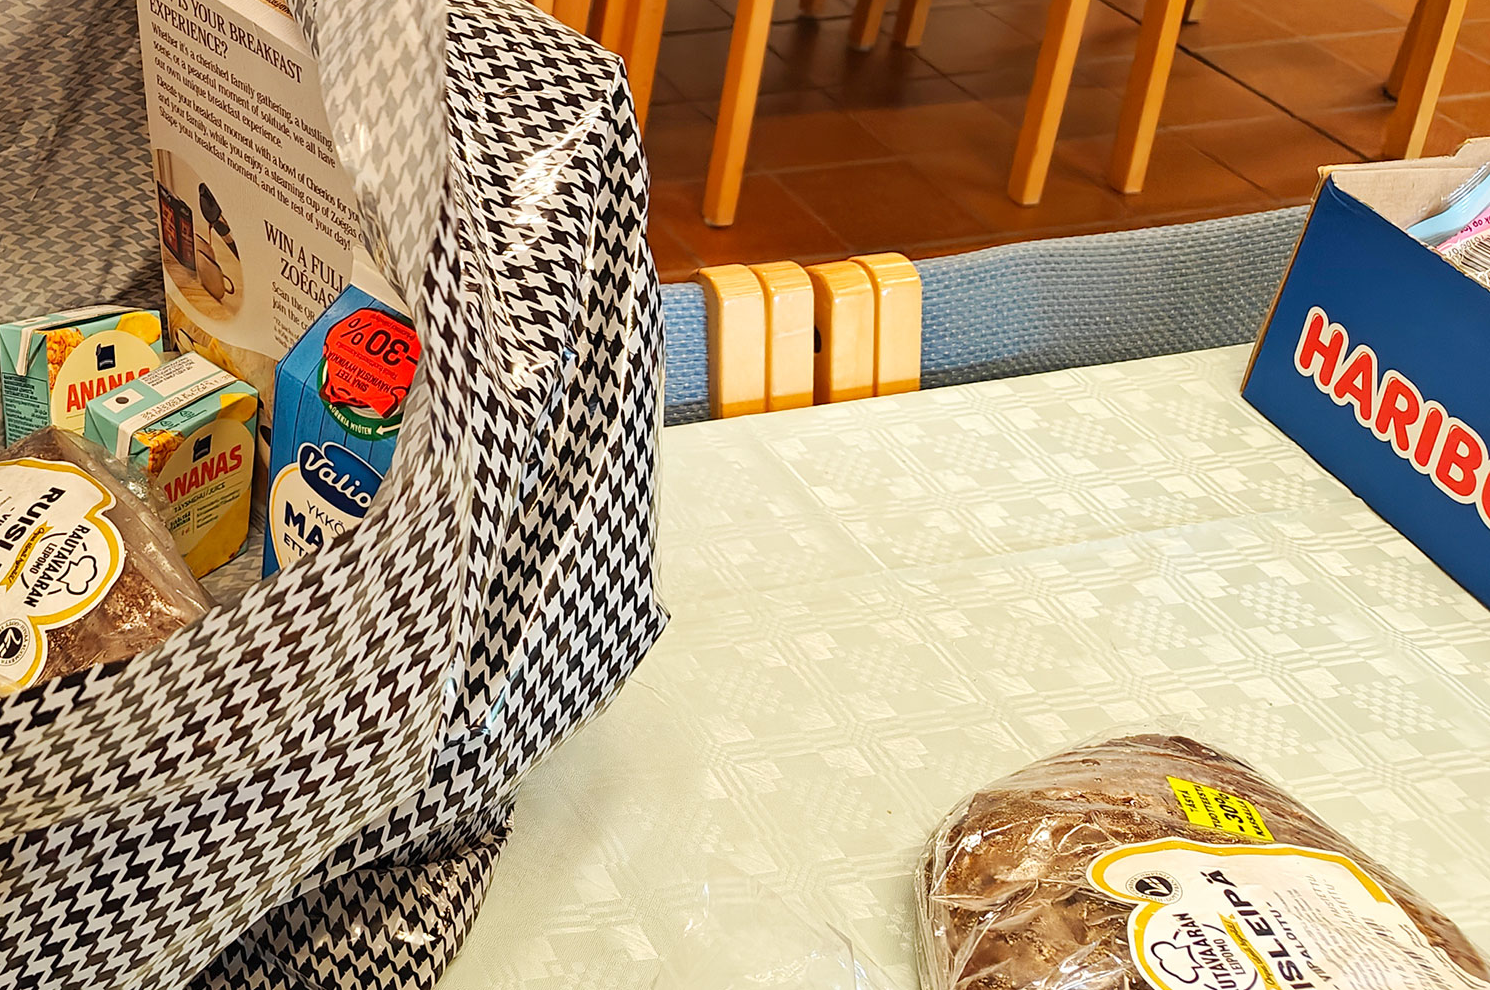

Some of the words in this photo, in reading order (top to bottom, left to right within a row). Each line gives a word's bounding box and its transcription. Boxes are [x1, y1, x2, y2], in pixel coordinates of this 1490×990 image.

[228, 20, 303, 86] BREAKFAST
[151, 20, 178, 50] Whether
[178, 38, 189, 56] it's
[189, 48, 195, 60] a
[195, 49, 229, 83] cherished
[229, 71, 255, 101] family
[255, 88, 293, 126] gathering,
[294, 118, 300, 128] a
[300, 118, 333, 153] bustling
[154, 54, 166, 71] our
[165, 64, 181, 82] own
[182, 72, 207, 102] unique
[206, 89, 240, 122] breakfast
[241, 111, 282, 153] experience.
[172, 52, 180, 66] or
[180, 58, 186, 70] a
[186, 60, 217, 93] peaceful
[217, 80, 250, 113] moment
[250, 100, 259, 118] of
[260, 107, 292, 140] solitude,
[292, 130, 305, 148] we
[305, 137, 315, 155] all
[317, 145, 335, 169] have
[157, 89, 170, 107] and
[170, 100, 185, 121] your
[185, 109, 208, 138] family,
[208, 125, 228, 150] while
[228, 141, 243, 162] you
[243, 148, 263, 177] enjoy
[263, 165, 269, 177] a
[270, 167, 305, 205] steaming
[305, 195, 320, 216] cup
[321, 202, 329, 219] of
[330, 209, 356, 242] Zoégas
[158, 104, 178, 131] Shape
[177, 120, 194, 143] your
[193, 130, 225, 163] breakfast
[226, 153, 260, 187] moment,
[260, 177, 275, 198] and
[276, 188, 289, 207] the
[290, 198, 304, 218] rest
[305, 207, 313, 224] of
[315, 216, 332, 241] your
[333, 228, 350, 254] day!
[177, 90, 192, 111] your
[191, 98, 222, 130] breakfast
[222, 119, 253, 151] moment
[254, 139, 271, 162] with
[271, 154, 278, 167] a
[277, 155, 296, 179] bowl
[296, 168, 305, 186] of
[305, 174, 335, 207] Cheerios
[336, 196, 347, 215] for
[263, 218, 294, 260] WIN
[296, 242, 308, 270] A
[271, 279, 290, 304] Scan
[291, 294, 303, 313] the
[303, 305, 315, 325] QR
[279, 250, 335, 315] ZOÉGAS
[271, 295, 287, 319] join
[287, 307, 299, 326] the
[340, 318, 418, 368] -30%
[334, 367, 353, 384] TEET
[304, 451, 374, 508] Valio
[23, 524, 91, 608] RAUTAVAARAN
[29, 542, 58, 575] LEIPOMO
[1176, 789, 1198, 812] TÄSTÄ
[1192, 784, 1223, 828] TUOTTEESTA
[1210, 791, 1246, 832] -30%
[1236, 799, 1266, 837] KASSALLA
[1213, 938, 1246, 975] LEIPOMO
[1269, 909, 1332, 983] VIIPALOITU
